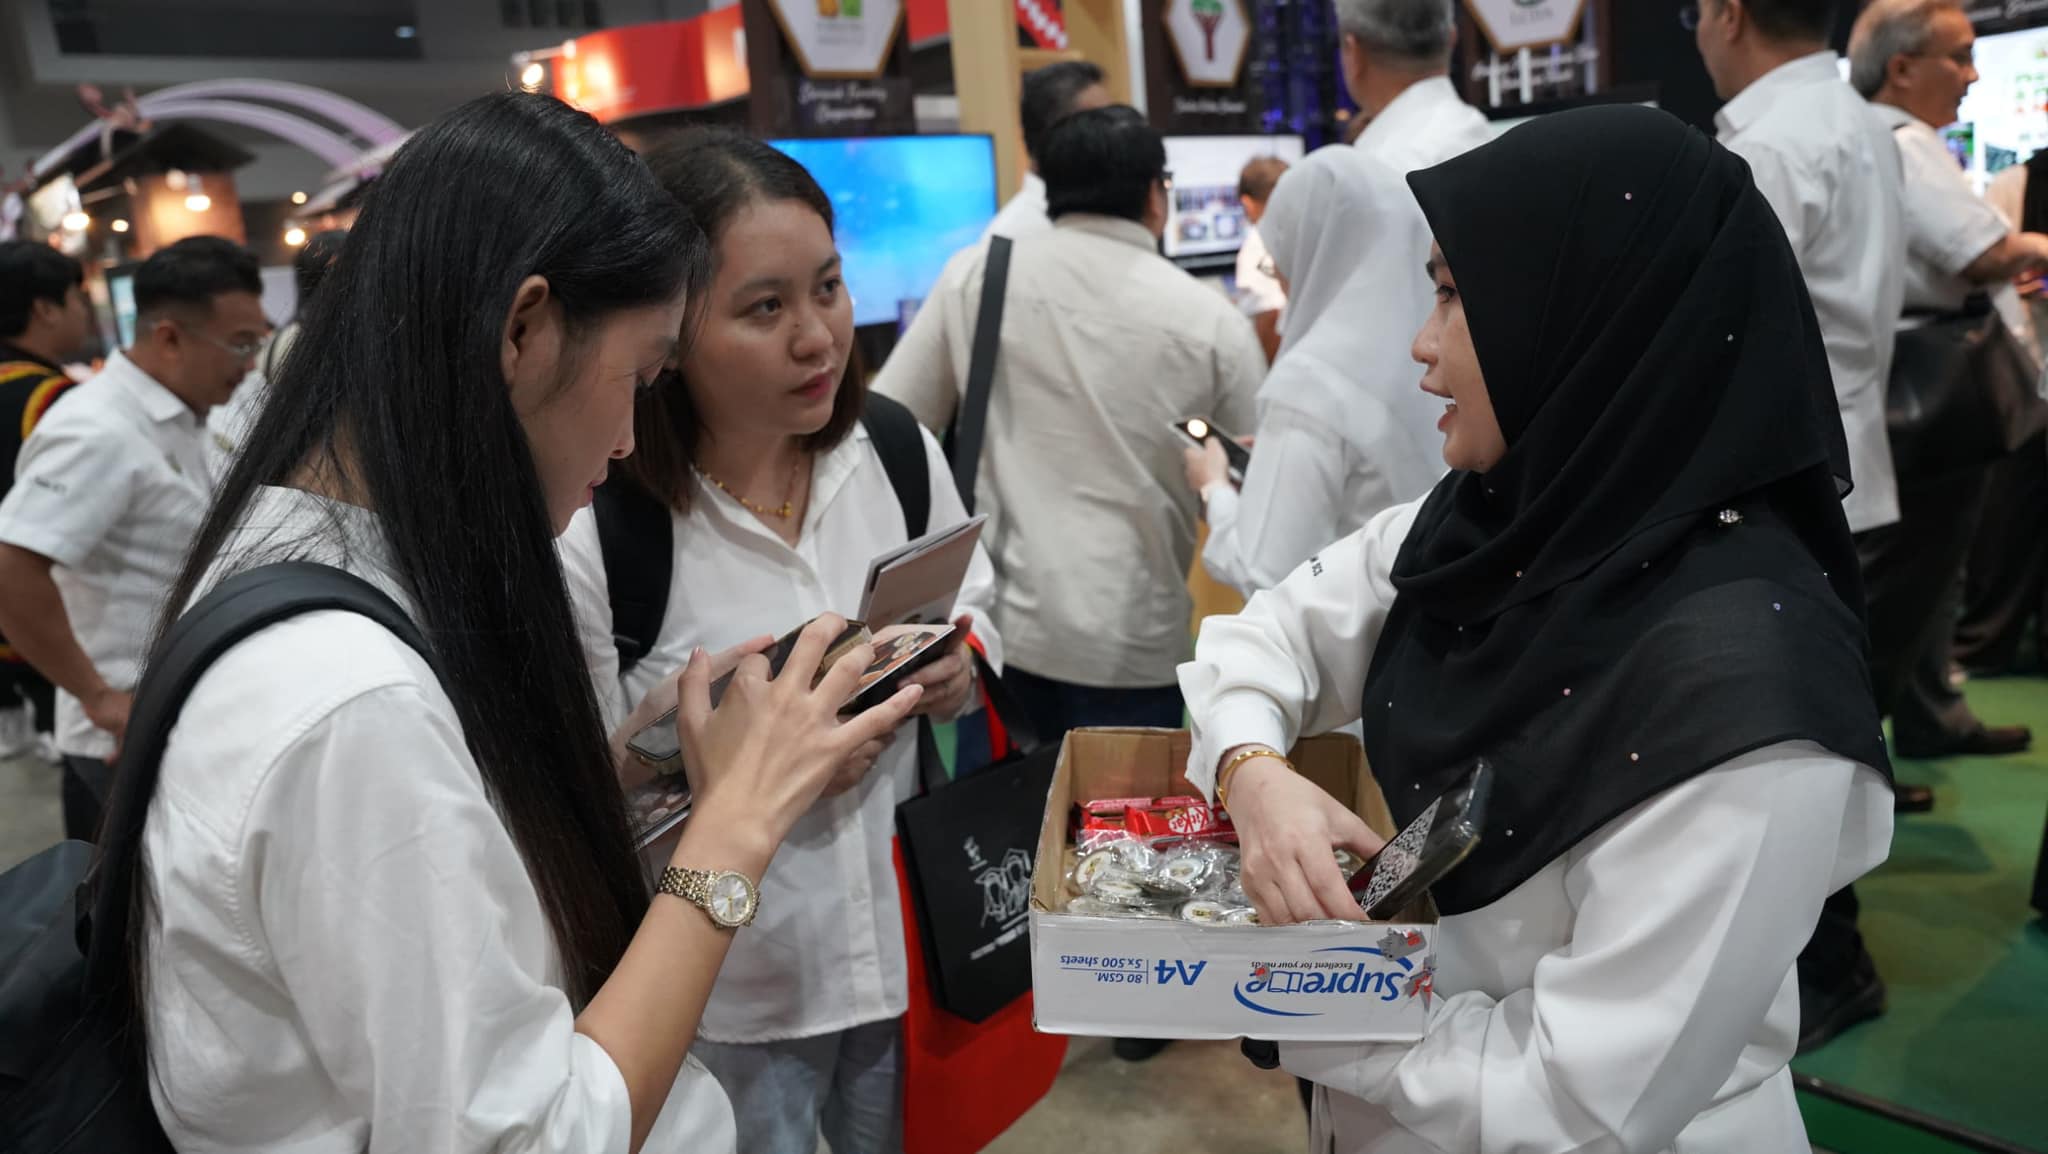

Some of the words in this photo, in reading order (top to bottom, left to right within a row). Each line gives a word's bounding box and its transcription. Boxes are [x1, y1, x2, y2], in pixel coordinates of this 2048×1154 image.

[1060, 955, 1099, 967] sheets
[1251, 960, 1277, 969] nds
[1278, 960, 1299, 969] your
[1299, 961, 1314, 970] for
[1315, 961, 1353, 970] Excellent
[1094, 972, 1124, 983] GSM.
[1154, 959, 1208, 986] A4
[1126, 973, 1143, 984] 80
[1245, 962, 1404, 1001] Supreme
